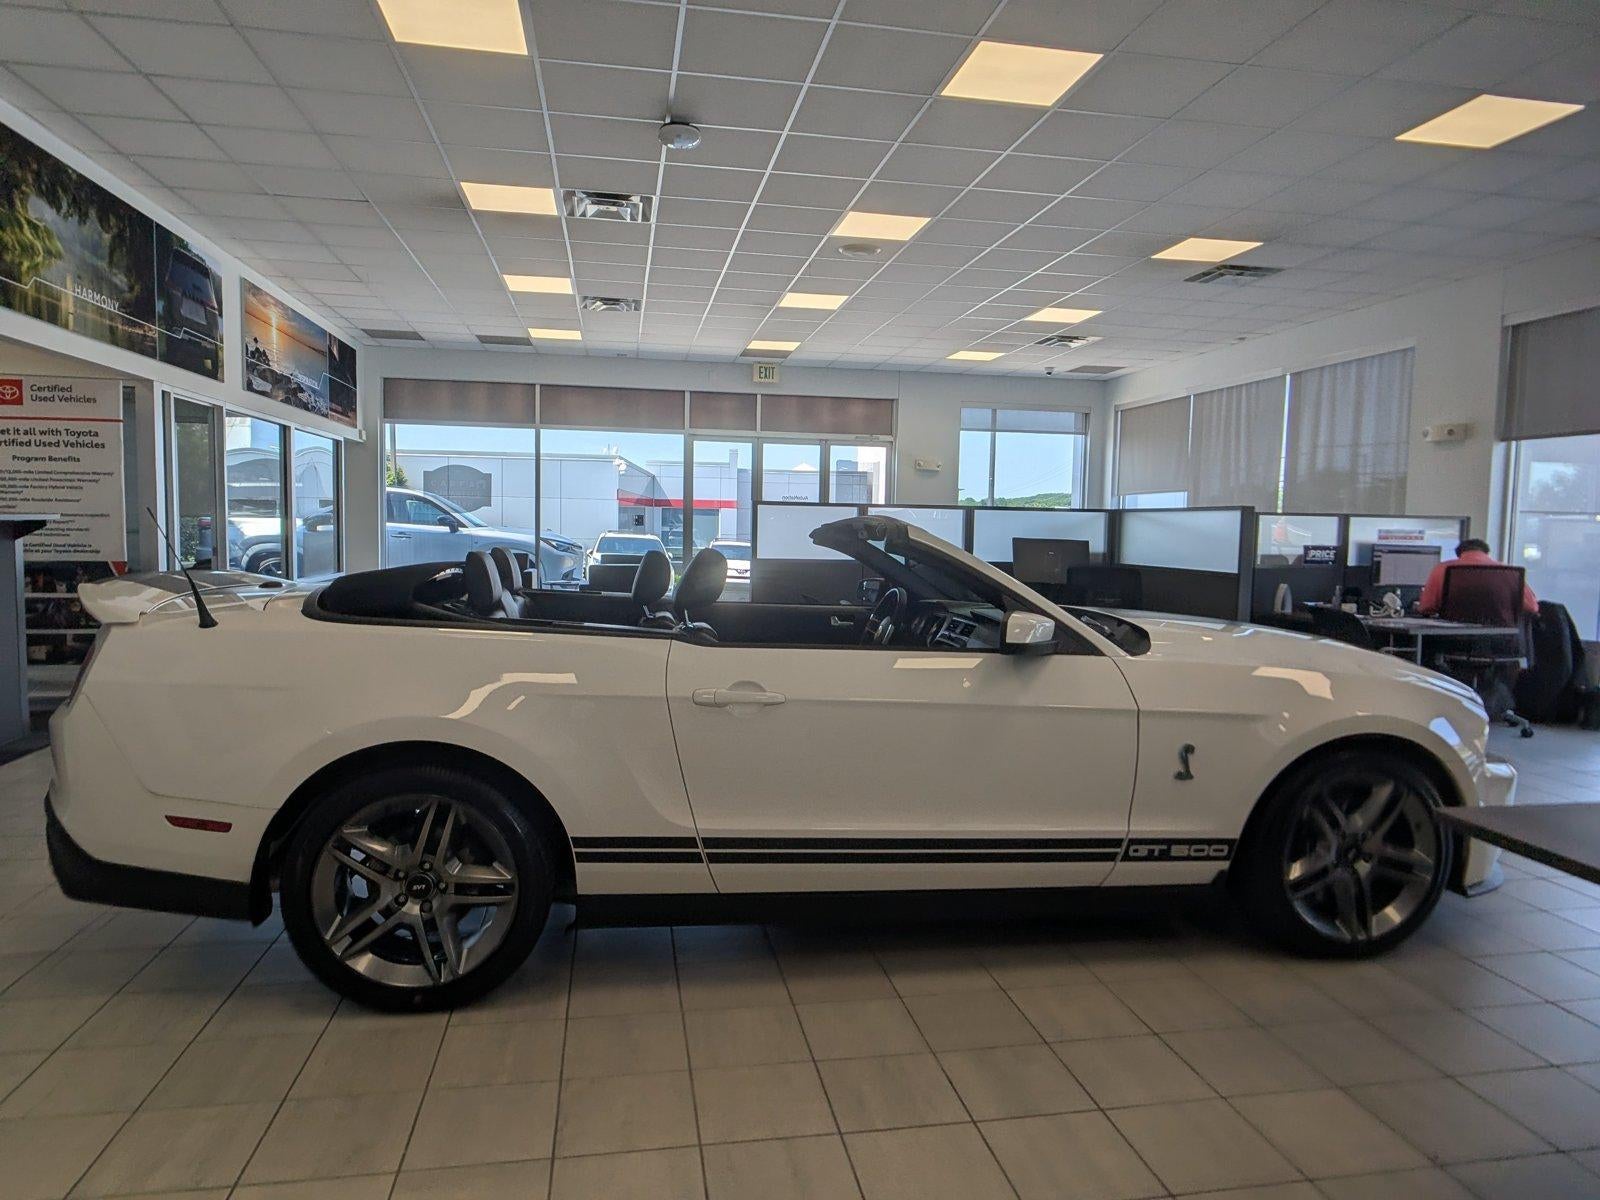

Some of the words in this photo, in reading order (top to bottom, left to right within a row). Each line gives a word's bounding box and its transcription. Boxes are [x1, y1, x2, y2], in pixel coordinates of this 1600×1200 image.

[75, 283, 119, 311] HARMONY
[758, 366, 776, 379] EXIT
[30, 384, 72, 393] Certified
[31, 394, 55, 403] Used
[57, 395, 97, 404] Vehicles
[0, 428, 11, 436] et
[13, 427, 21, 436] it
[23, 427, 36, 437] all
[39, 428, 61, 437] with
[64, 428, 99, 439] Toyota
[0, 438, 31, 448] rtified
[34, 439, 60, 448] Used
[63, 440, 106, 449] Vehicles
[12, 455, 46, 463] Program
[48, 455, 80, 463] Benefits
[1129, 844, 1167, 857] GT
[1170, 844, 1229, 857] 500
